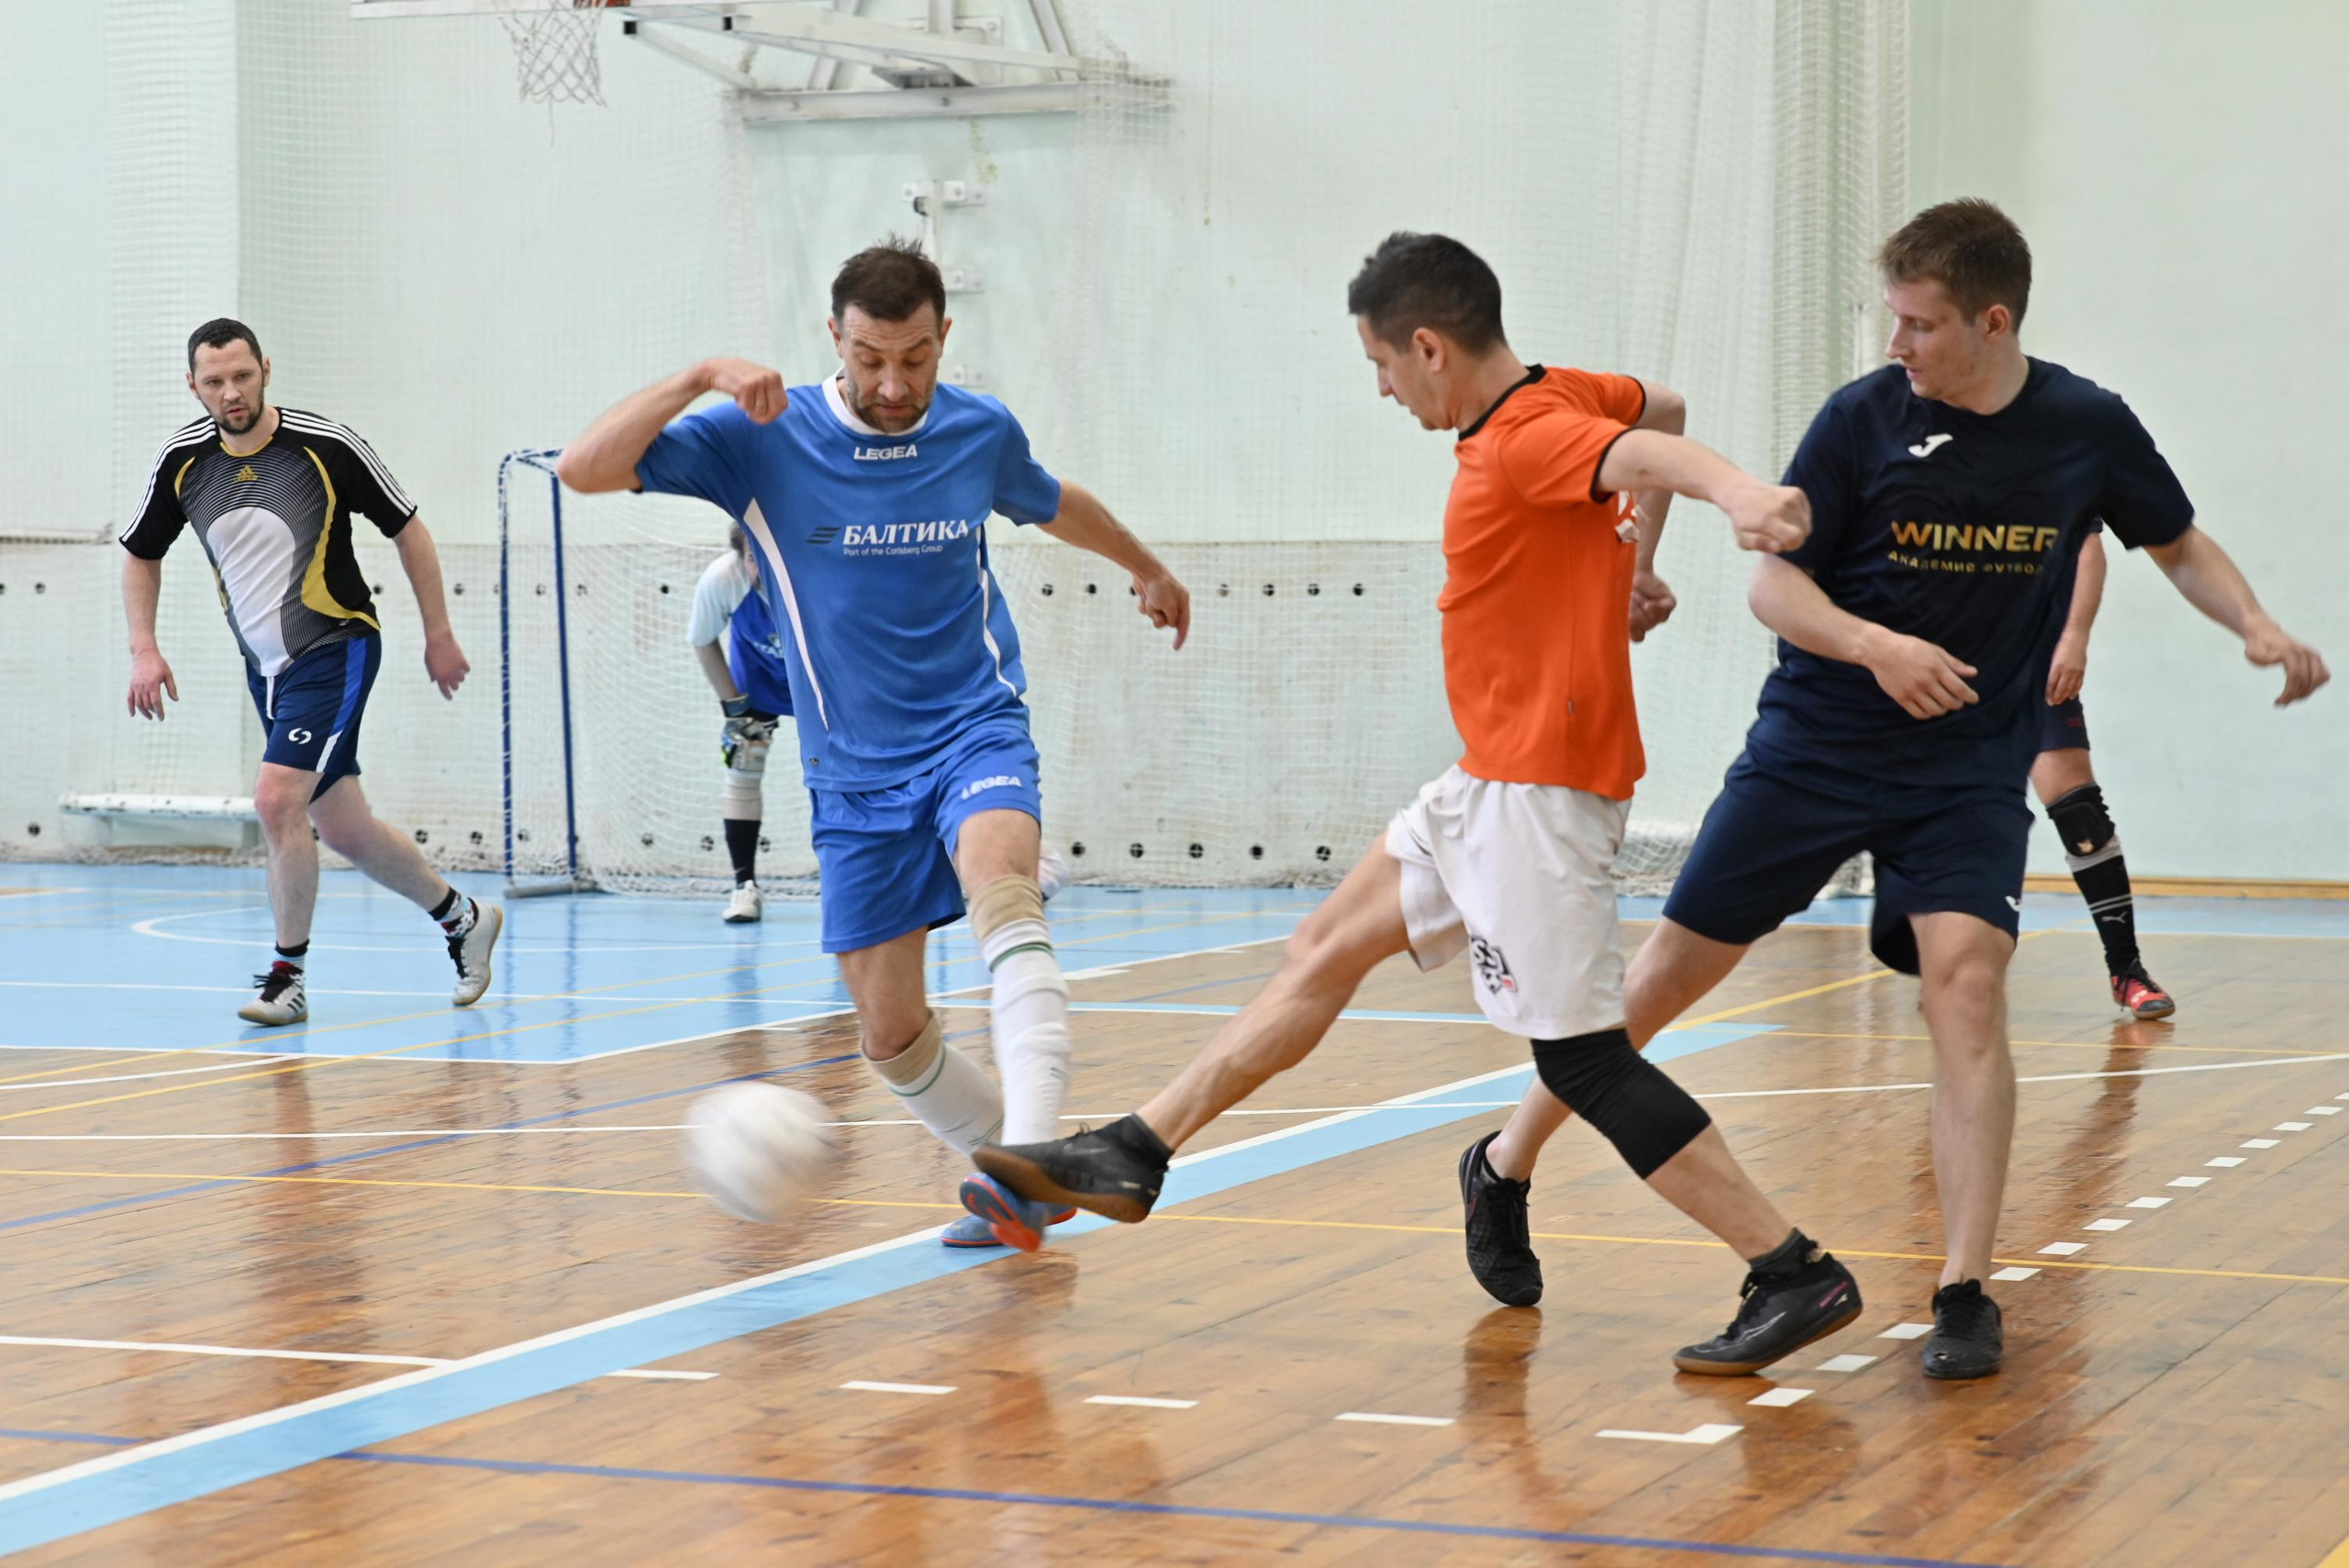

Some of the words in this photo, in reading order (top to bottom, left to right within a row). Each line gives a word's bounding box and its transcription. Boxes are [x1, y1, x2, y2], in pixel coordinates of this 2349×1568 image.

[853, 444, 918, 461] LEGEA
[841, 519, 969, 546] БАЛТИКА
[1890, 519, 2059, 551] WINNER
[843, 547, 860, 556] Part
[861, 547, 870, 556] of
[871, 547, 884, 556] the
[885, 546, 920, 556] Carlsberg
[921, 544, 943, 553] Group
